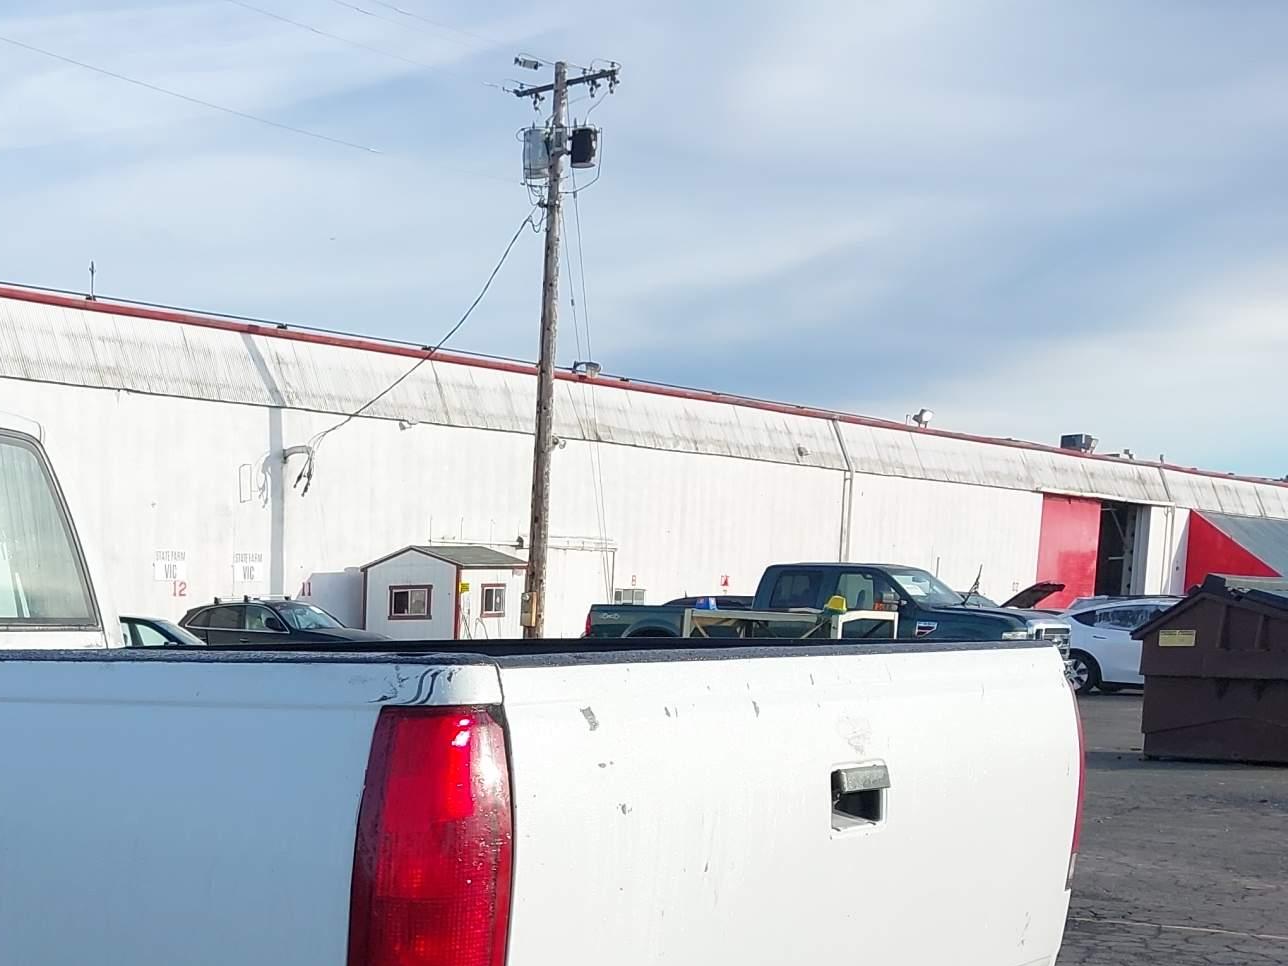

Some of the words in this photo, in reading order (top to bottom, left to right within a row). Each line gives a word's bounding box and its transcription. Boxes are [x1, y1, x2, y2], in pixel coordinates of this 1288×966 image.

[156, 551, 170, 561] STATE
[164, 562, 177, 579] VIC
[243, 565, 255, 580] VIC
[172, 580, 187, 597] 12
